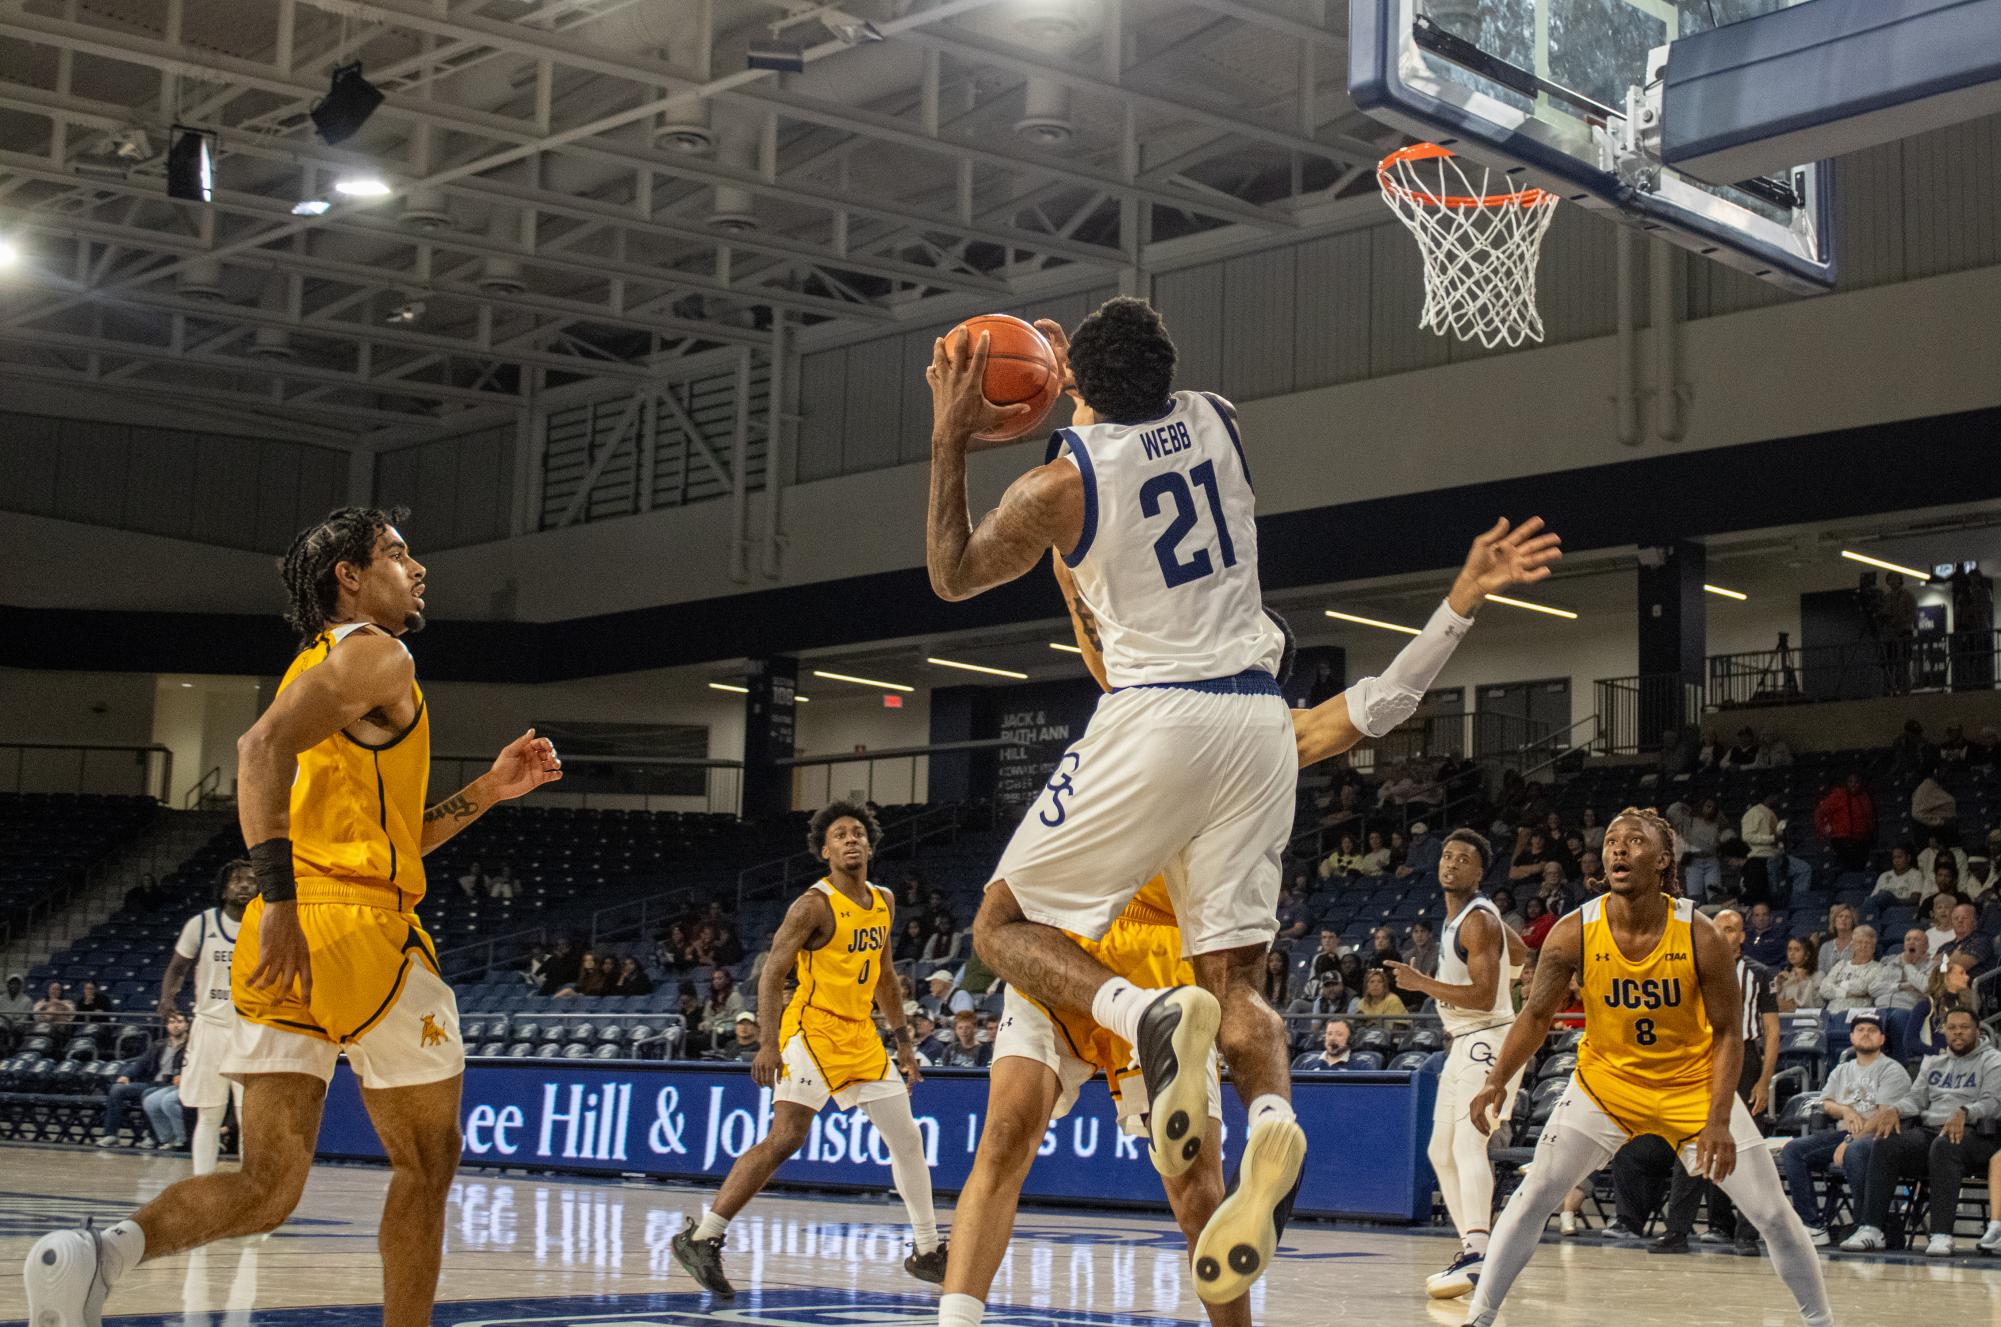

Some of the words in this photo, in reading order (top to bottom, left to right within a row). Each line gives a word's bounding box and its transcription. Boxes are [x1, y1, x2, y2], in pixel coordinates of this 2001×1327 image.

[1140, 421, 1192, 460] WEBB
[1139, 458, 1237, 588] 21
[1001, 713, 1035, 728] JACK
[1039, 725, 1069, 742] ANN
[1000, 747, 1028, 761] HILL
[848, 926, 887, 953] JCSU
[858, 959, 870, 985] 0
[1604, 978, 1681, 1009] JCSU
[1635, 1018, 1657, 1046] 8
[1928, 1070, 1977, 1089] GATA
[461, 1104, 524, 1155] ee
[537, 1082, 632, 1161] Hill
[648, 1086, 688, 1155] &
